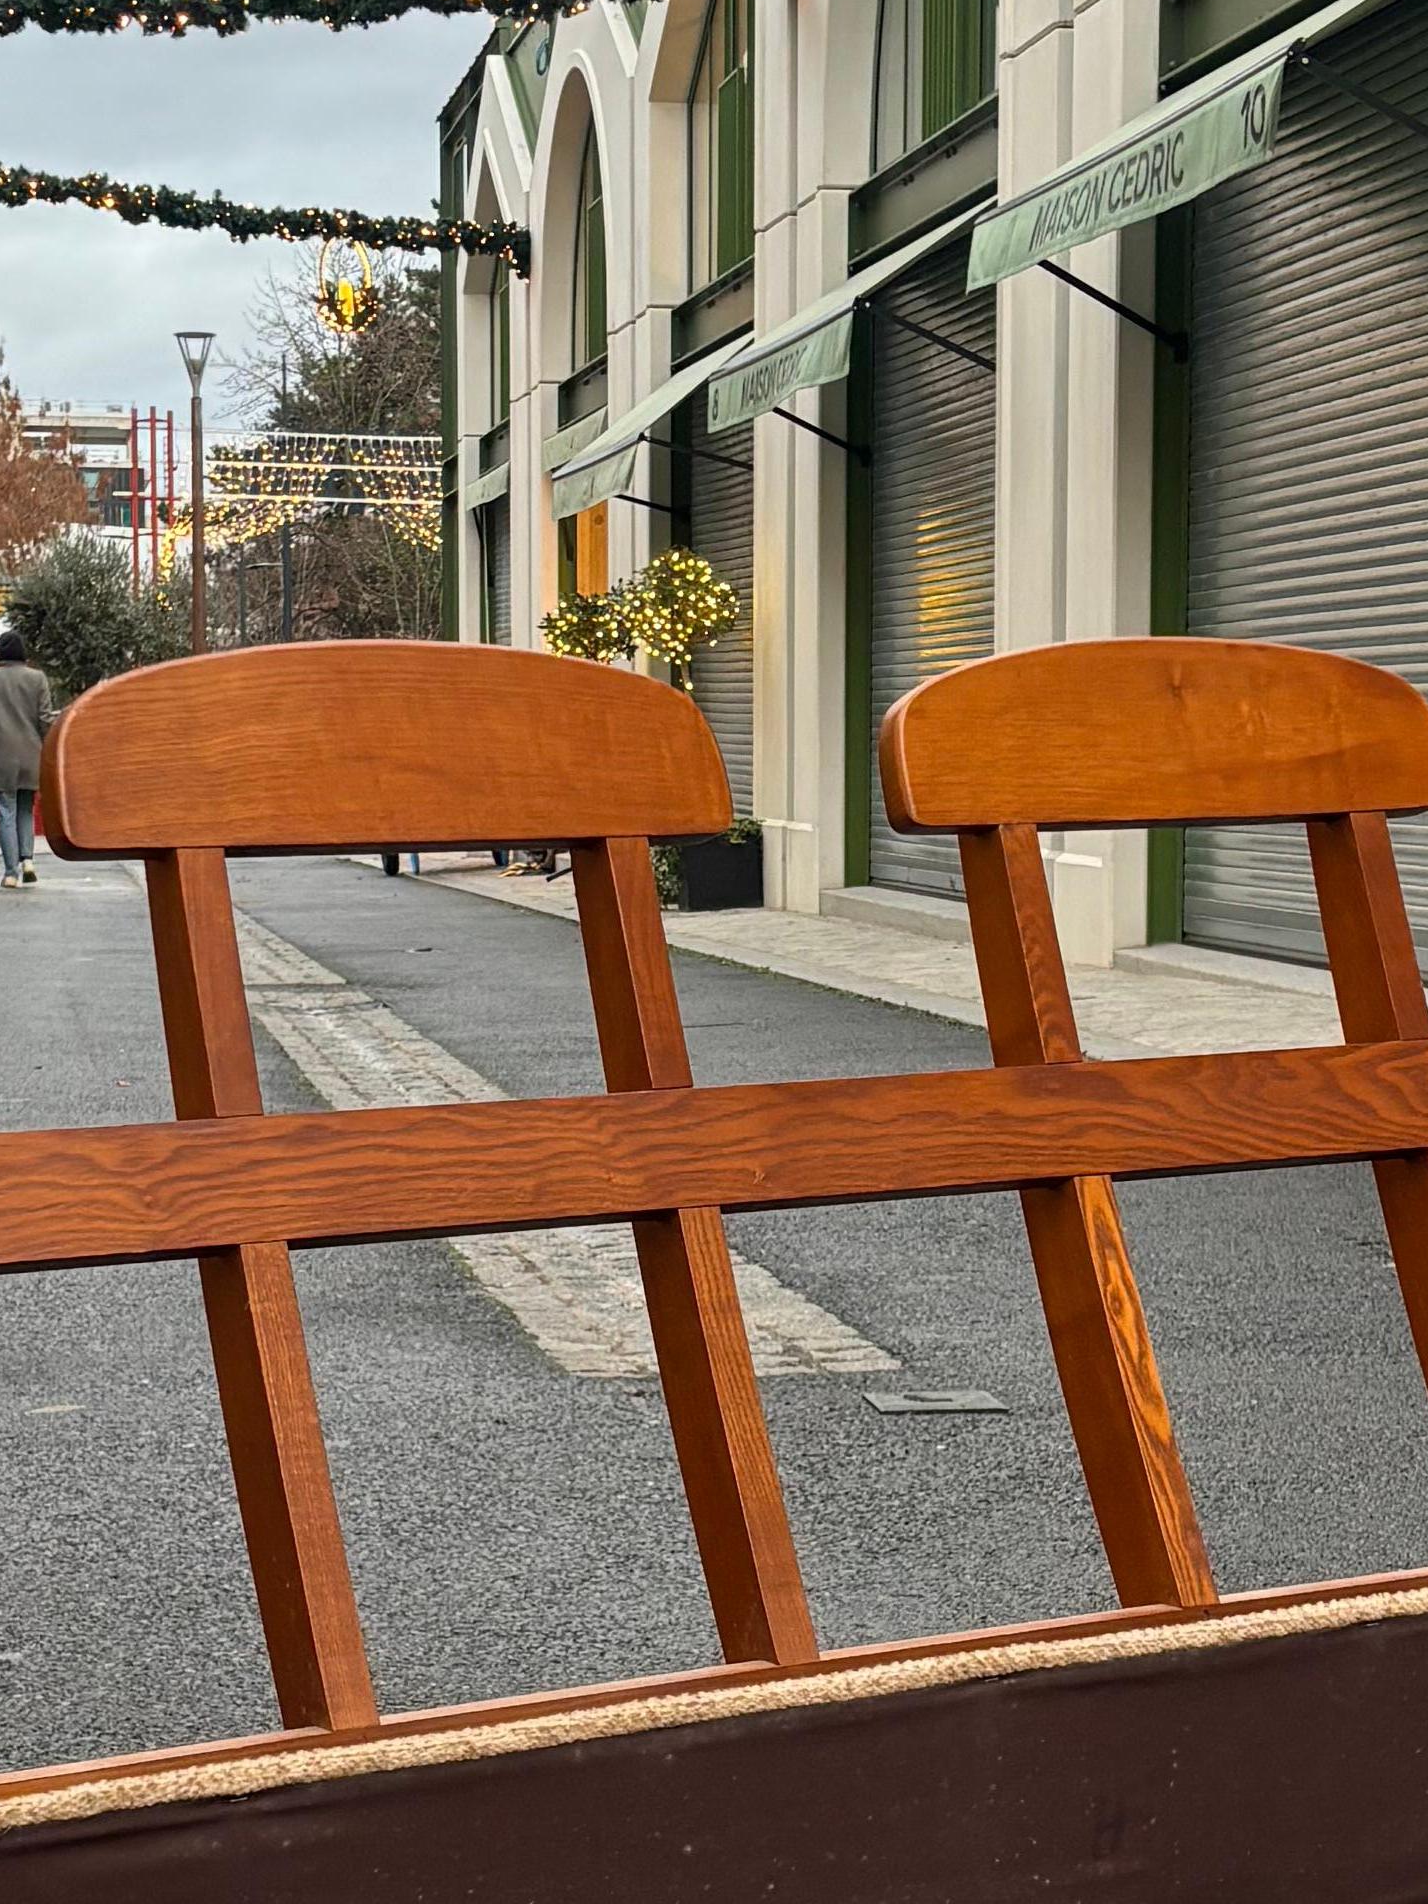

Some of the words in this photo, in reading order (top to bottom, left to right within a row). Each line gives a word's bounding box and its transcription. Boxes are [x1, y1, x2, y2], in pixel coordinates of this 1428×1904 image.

[1028, 170, 1107, 253] MAISON
[1107, 129, 1185, 214] CEDRIC
[1240, 83, 1266, 149] 10
